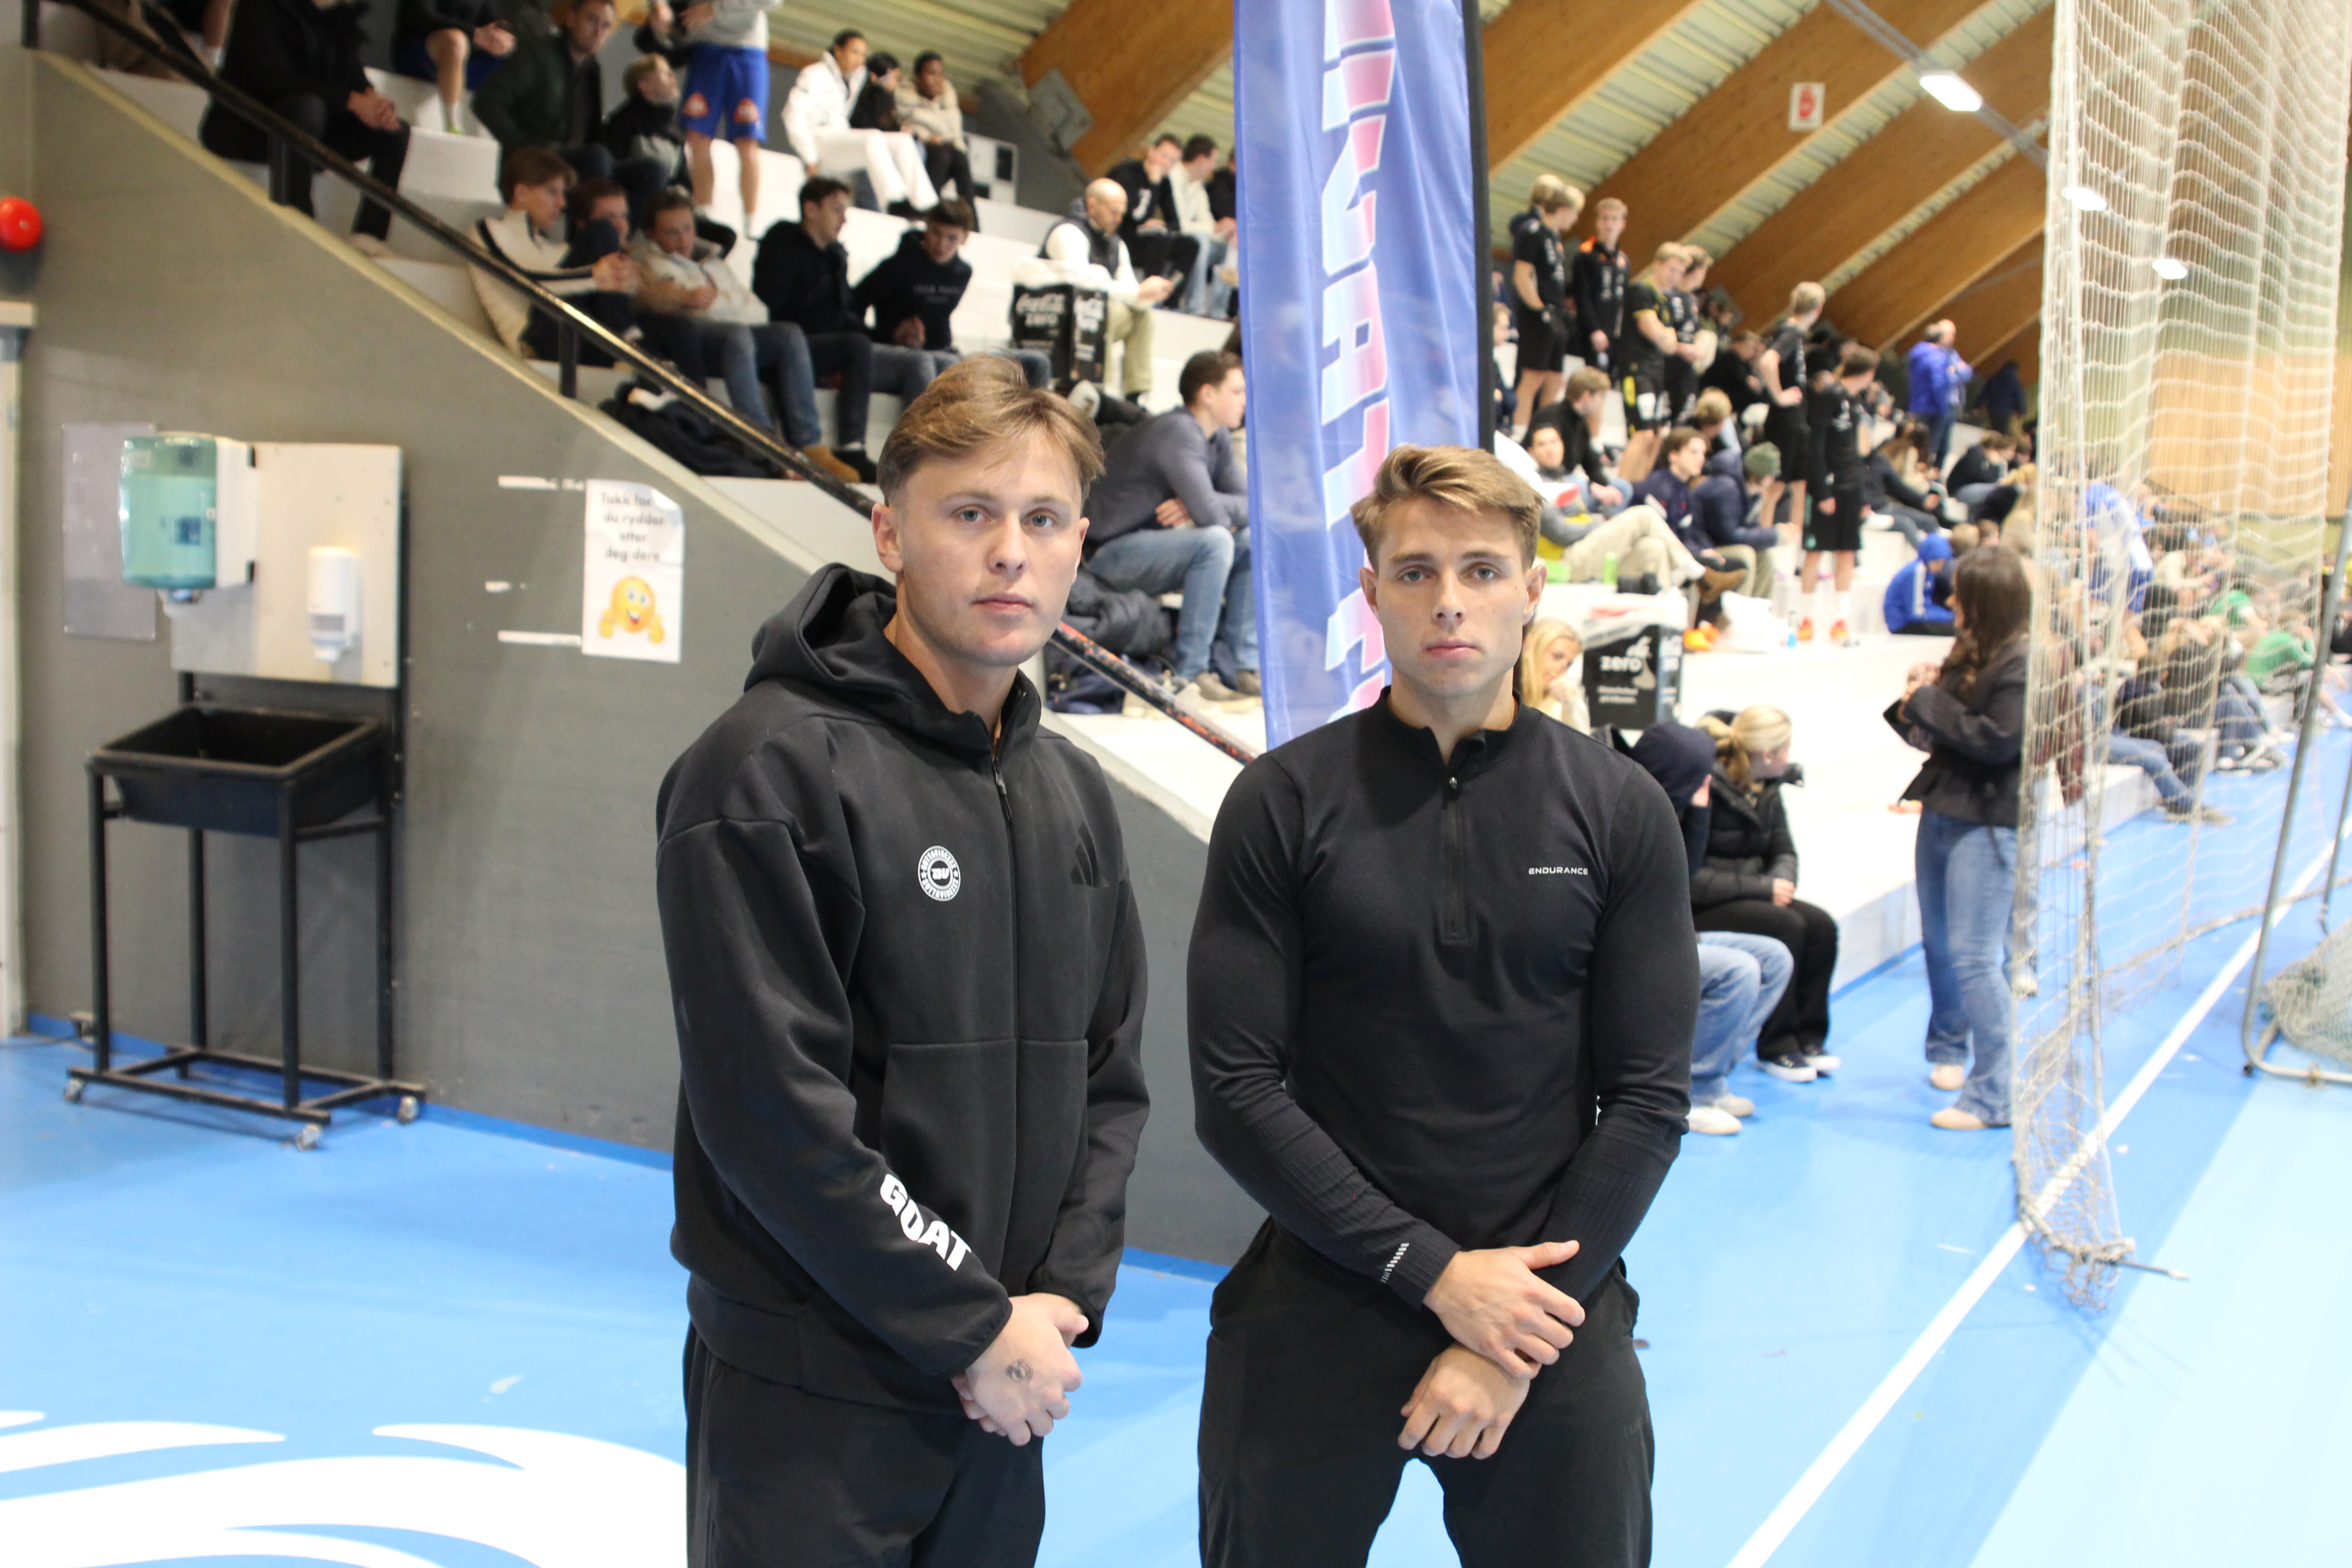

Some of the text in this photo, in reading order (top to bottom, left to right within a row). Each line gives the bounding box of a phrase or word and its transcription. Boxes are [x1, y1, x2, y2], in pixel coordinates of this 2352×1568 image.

[602, 493, 630, 505] Takk
[603, 511, 664, 526] du rydder
[605, 546, 627, 562] deg
[1600, 656, 1642, 672] zero
[1529, 867, 1588, 875] ENDURANCE
[880, 1173, 971, 1271] GOAT
